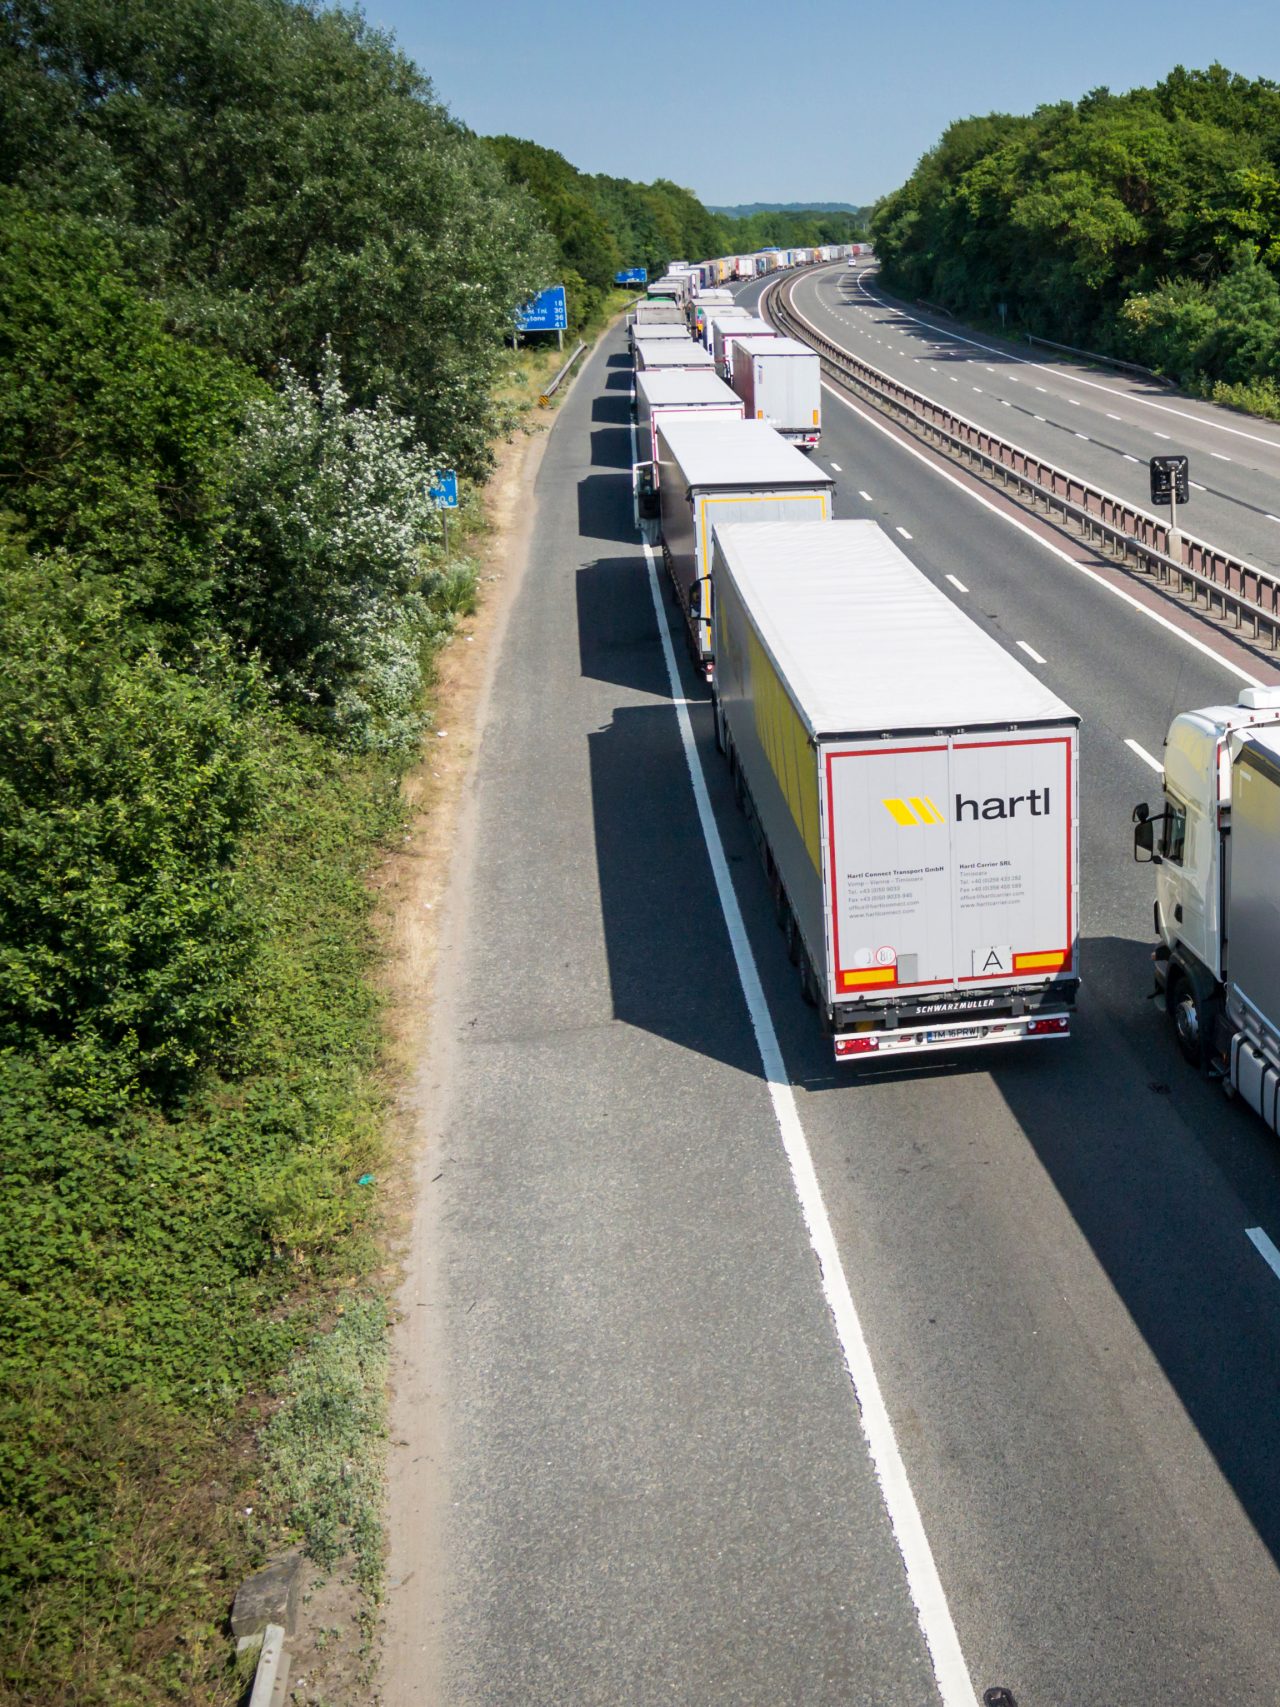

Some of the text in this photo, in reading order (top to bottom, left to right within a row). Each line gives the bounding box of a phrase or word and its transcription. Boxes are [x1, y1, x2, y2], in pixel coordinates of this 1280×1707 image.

[955, 787, 1050, 822] hartl
[893, 868, 924, 876] Transport
[982, 950, 1003, 971] A
[933, 1031, 946, 1039] TM
[956, 1026, 976, 1037] PRW
